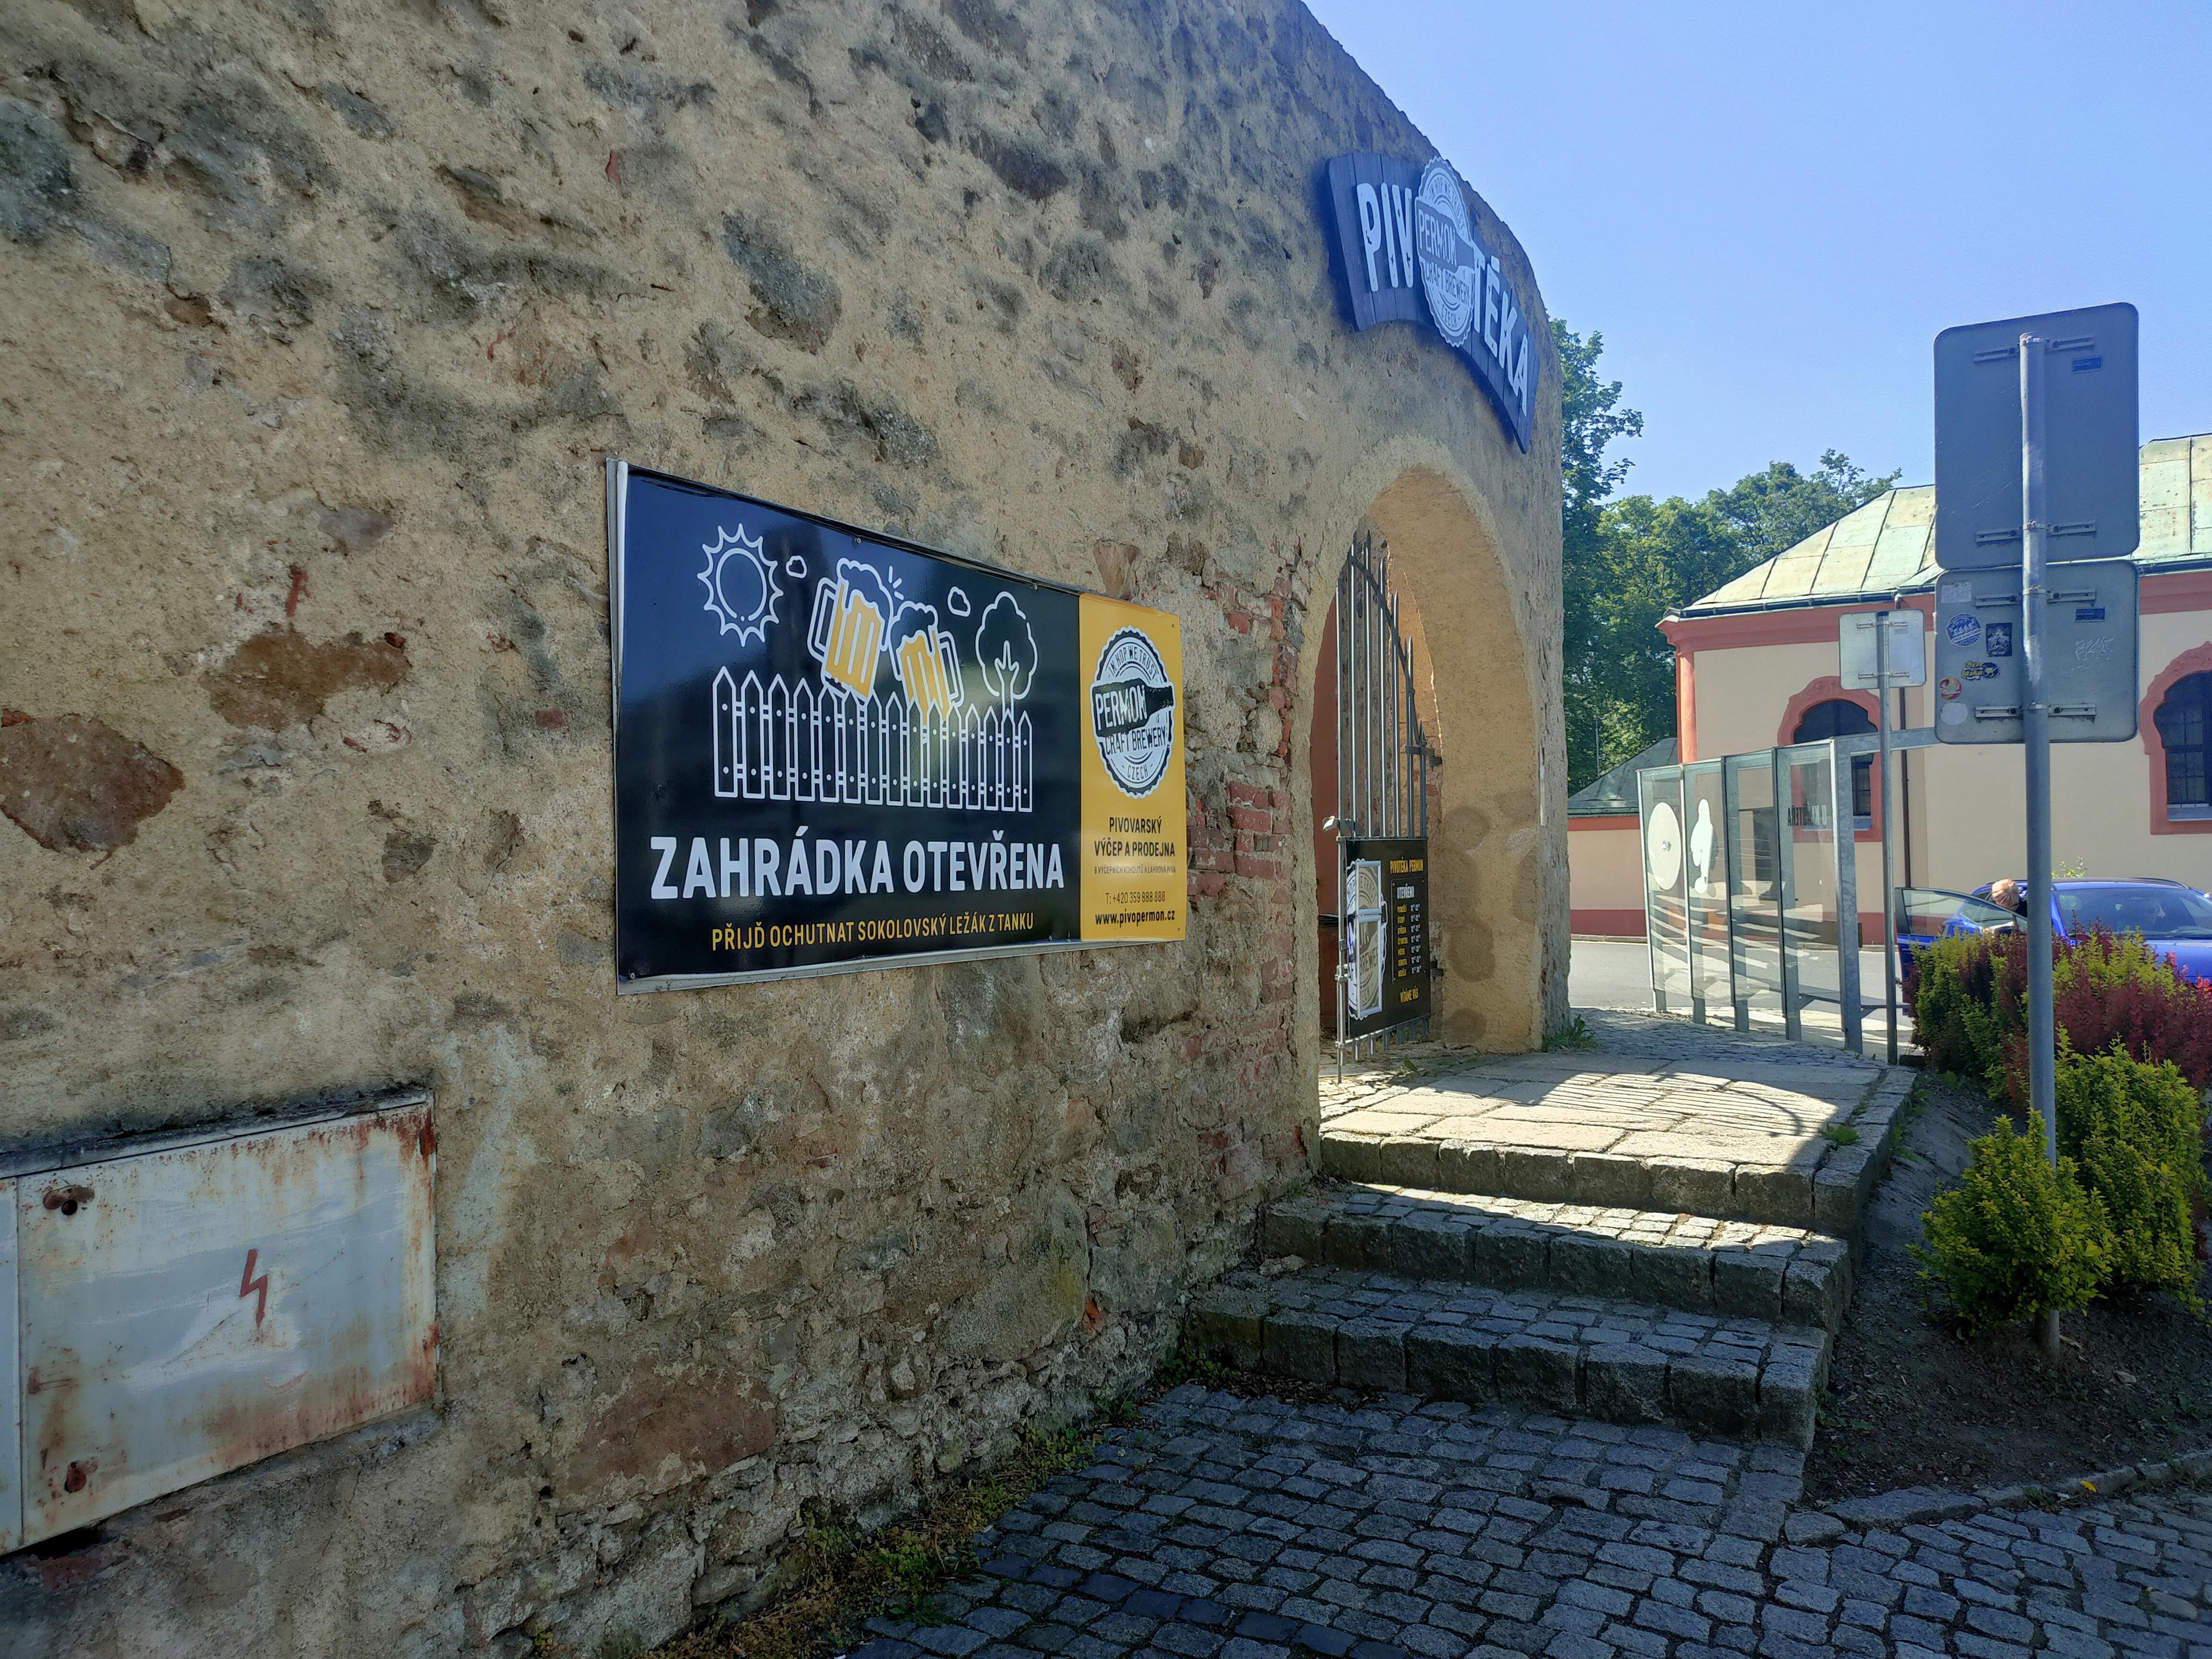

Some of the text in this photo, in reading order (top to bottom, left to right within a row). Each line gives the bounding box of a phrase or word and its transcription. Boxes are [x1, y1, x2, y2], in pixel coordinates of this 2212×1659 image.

[1418, 208, 1457, 267] PERMON
[1425, 259, 1469, 306] CRAFT BREWERY
[1442, 304, 1457, 328] CZECH
[1109, 645, 1159, 679] IN HOP WE TRUST
[1095, 685, 1147, 731] PERMON
[1105, 725, 1166, 755] CRAFT BREWERY
[1128, 764, 1149, 780] CZECH
[1109, 816, 1162, 833] PIVOVARSKÝ
[1094, 837, 1175, 857] VÝČEP A PRODEJNA
[650, 826, 1065, 899] ZAHRÁDKA OTEVŘENA
[1409, 859, 1423, 873] PERMON
[1105, 891, 1165, 904] T: +420 359 888 888
[712, 911, 1034, 951] PŘIJĎ OCHUTNAT SOKOLOVSKÝ LEŽÁK Z TANKU
[1095, 908, 1175, 928] www.pivopermon.cz
